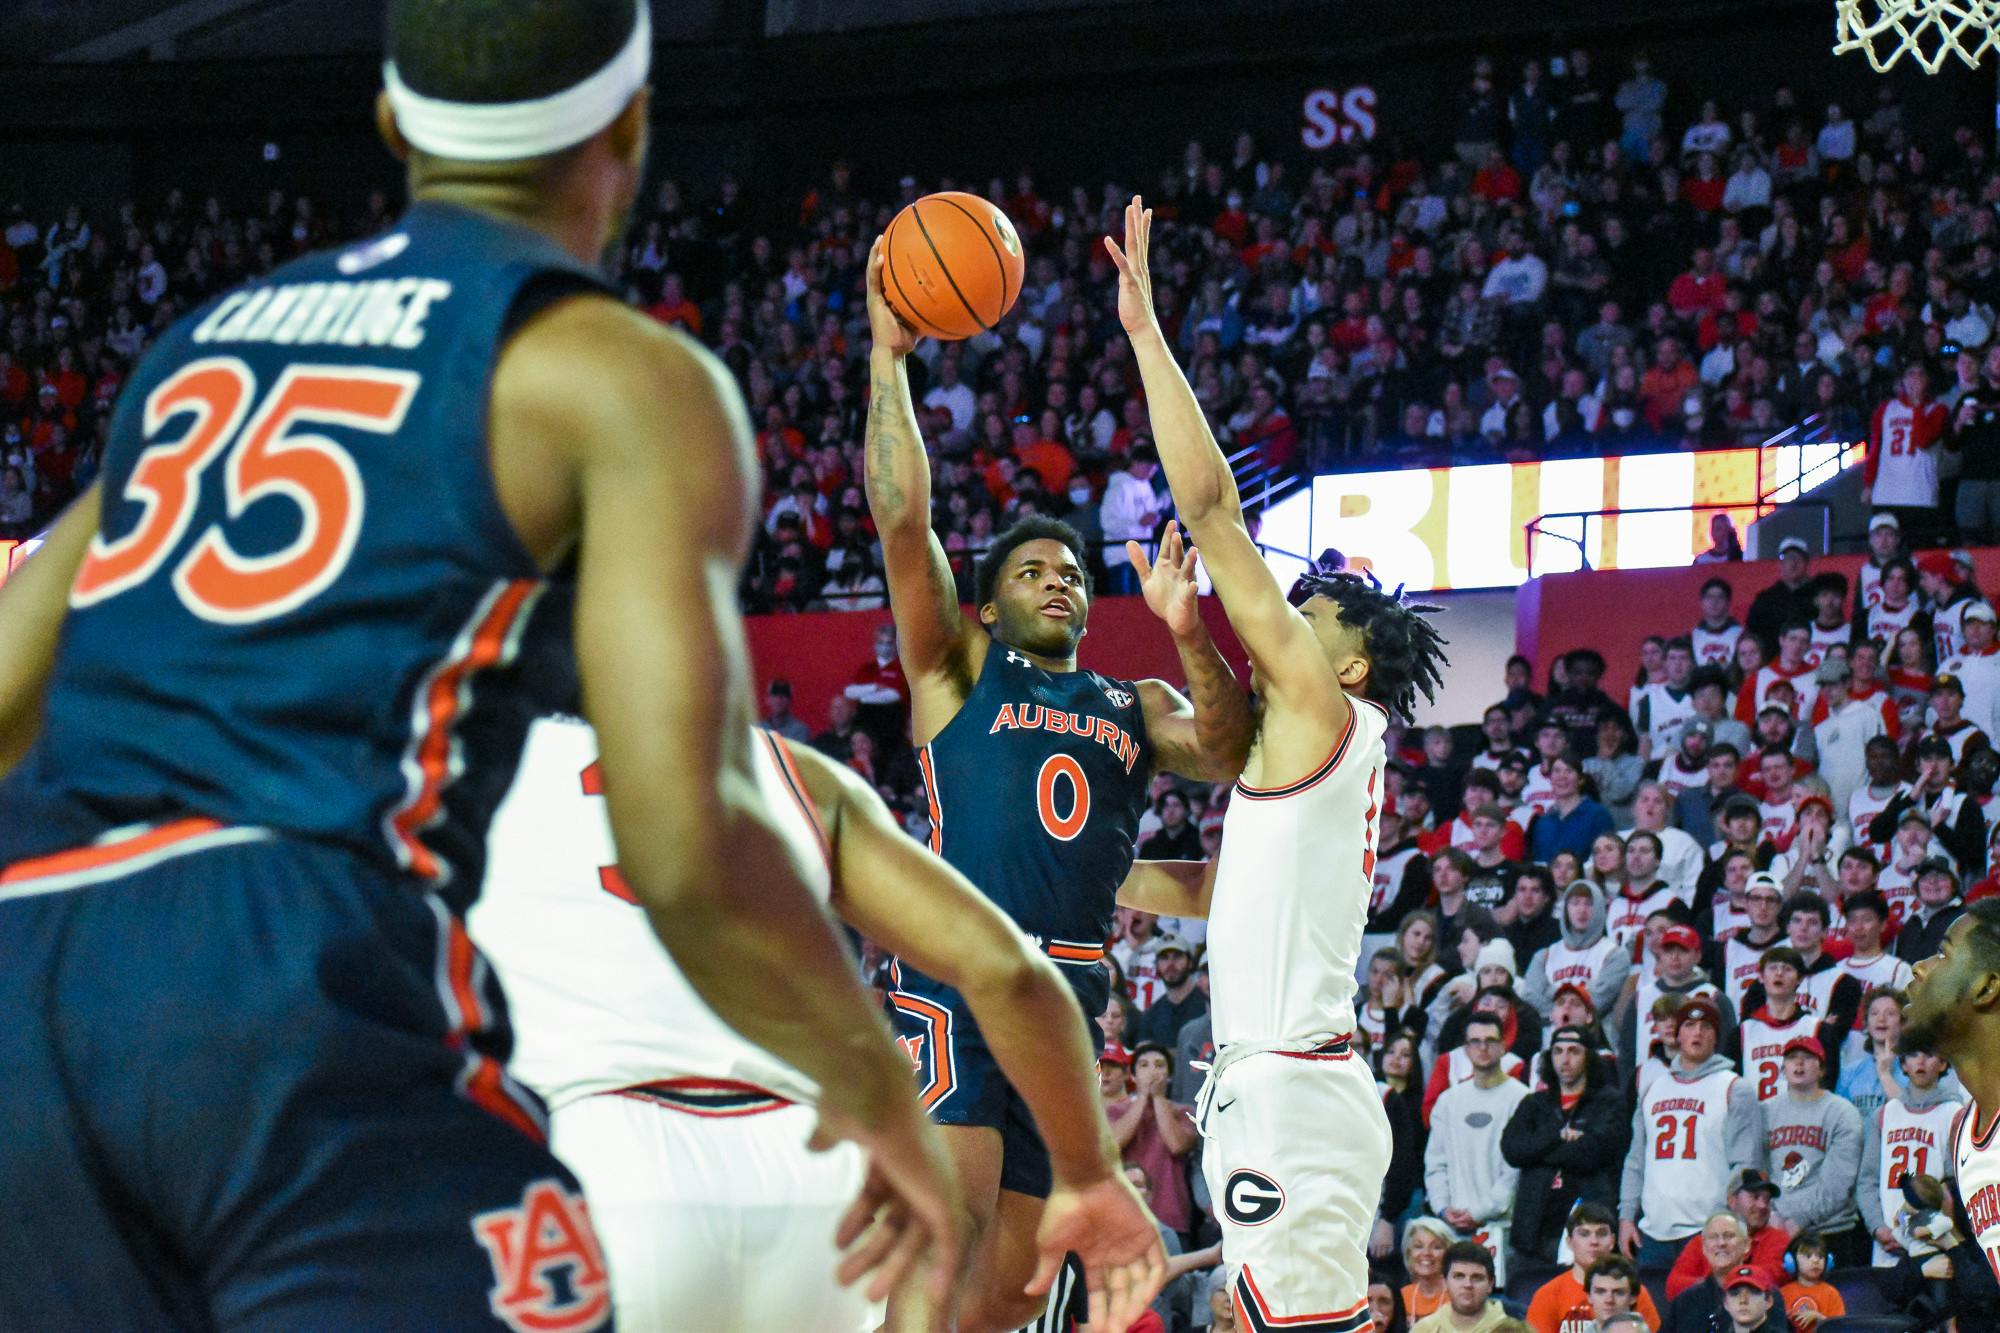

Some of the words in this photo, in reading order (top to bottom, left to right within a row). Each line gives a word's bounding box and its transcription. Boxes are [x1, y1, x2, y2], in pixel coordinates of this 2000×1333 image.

[69, 356, 422, 626] 35
[1105, 688, 1134, 709] SEC
[989, 703, 1141, 775] AUBURN
[1037, 753, 1091, 841] 0
[1651, 1097, 1706, 1116] GEORGIA
[1655, 1114, 1698, 1160] 21
[1887, 1127, 1934, 1147] GEORGIA
[1888, 1146, 1928, 1189] 21
[1224, 1167, 1286, 1226] G
